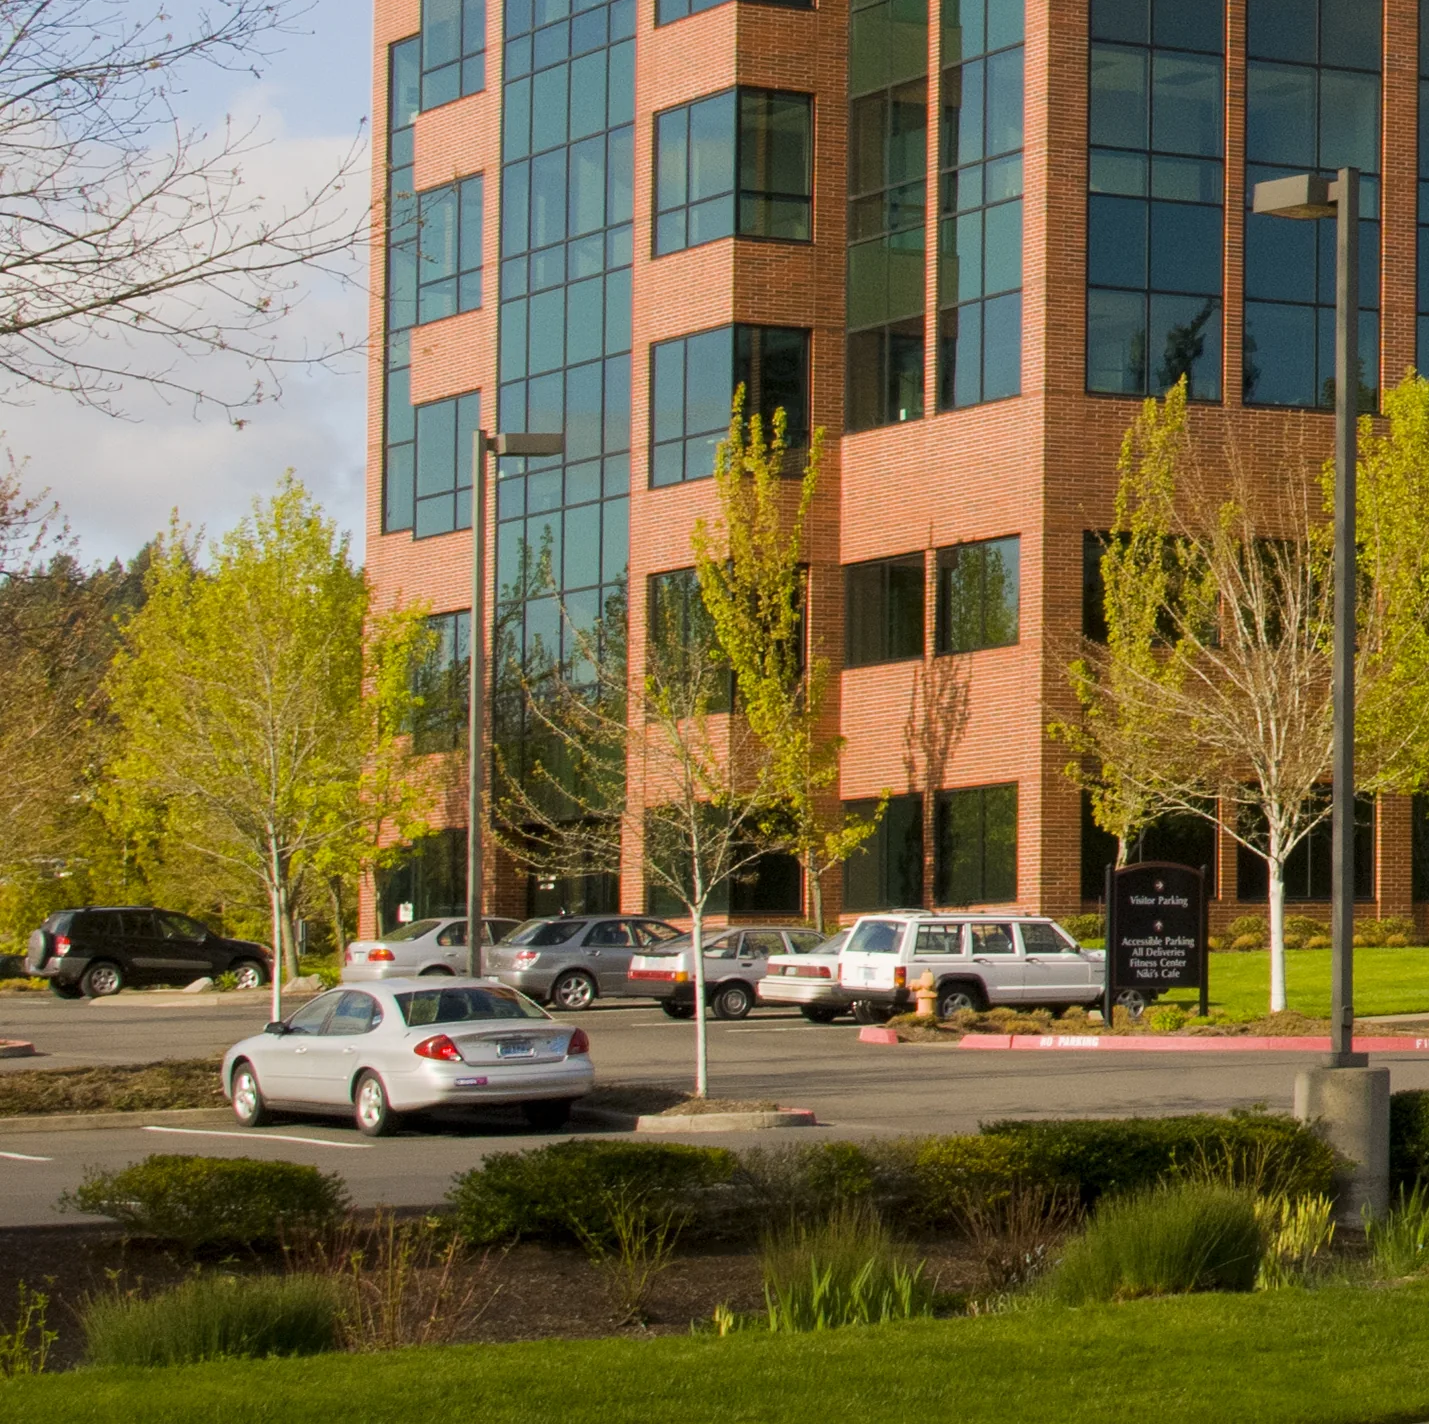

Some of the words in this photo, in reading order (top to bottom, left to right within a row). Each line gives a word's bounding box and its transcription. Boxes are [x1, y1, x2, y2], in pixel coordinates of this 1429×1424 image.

[1130, 895, 1156, 905] Visitor
[1158, 895, 1189, 908] Parking
[1121, 936, 1163, 946] Accessible
[1165, 936, 1195, 948] Parking
[1132, 947, 1144, 956] All
[1145, 947, 1186, 956] Deliveries
[1129, 958, 1158, 967] Fitness
[1160, 957, 1187, 967] Center
[1040, 1036, 1053, 1047] NO
[1058, 1036, 1099, 1047] PARKING
